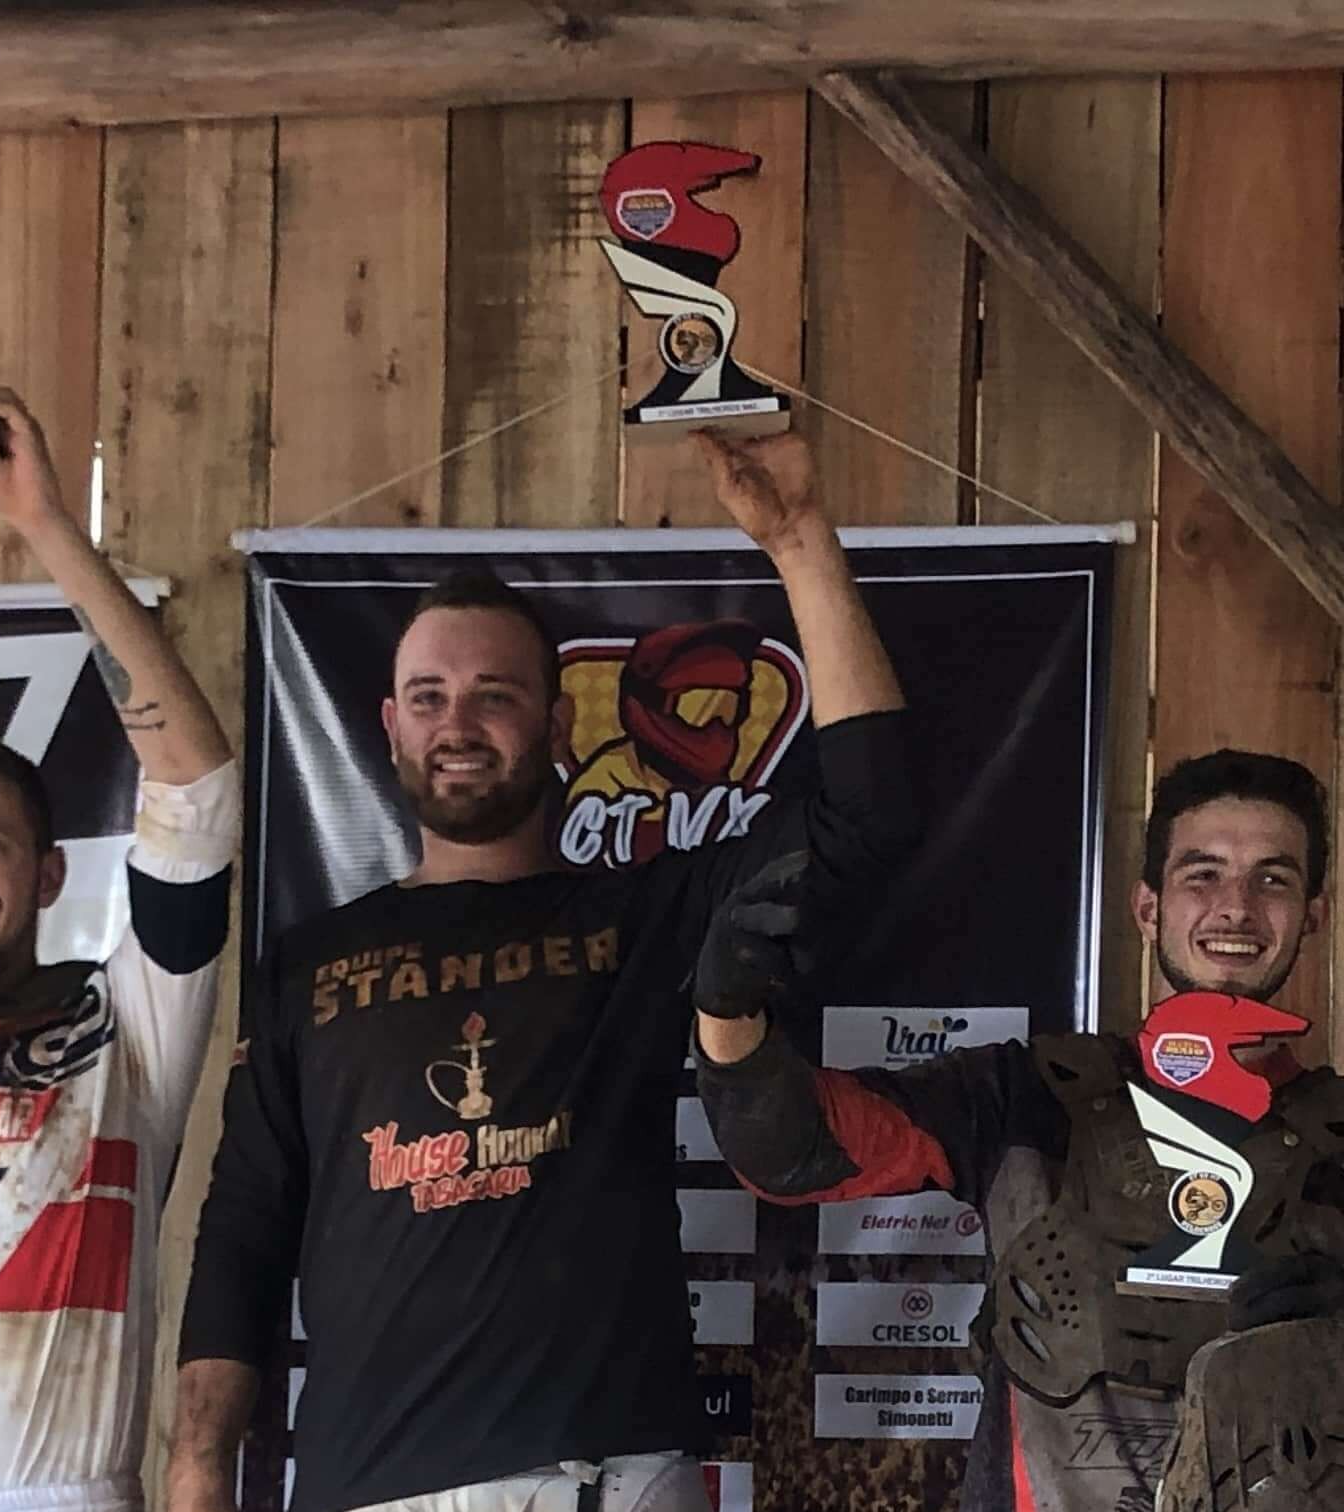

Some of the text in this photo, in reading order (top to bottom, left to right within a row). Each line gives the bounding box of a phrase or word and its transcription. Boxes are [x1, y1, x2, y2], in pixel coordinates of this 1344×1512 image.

[312, 927, 617, 1026] STANDER
[871, 1324, 962, 1343] CRESOL
[927, 1386, 982, 1404] Serrari
[877, 1409, 953, 1427] Simonetti
